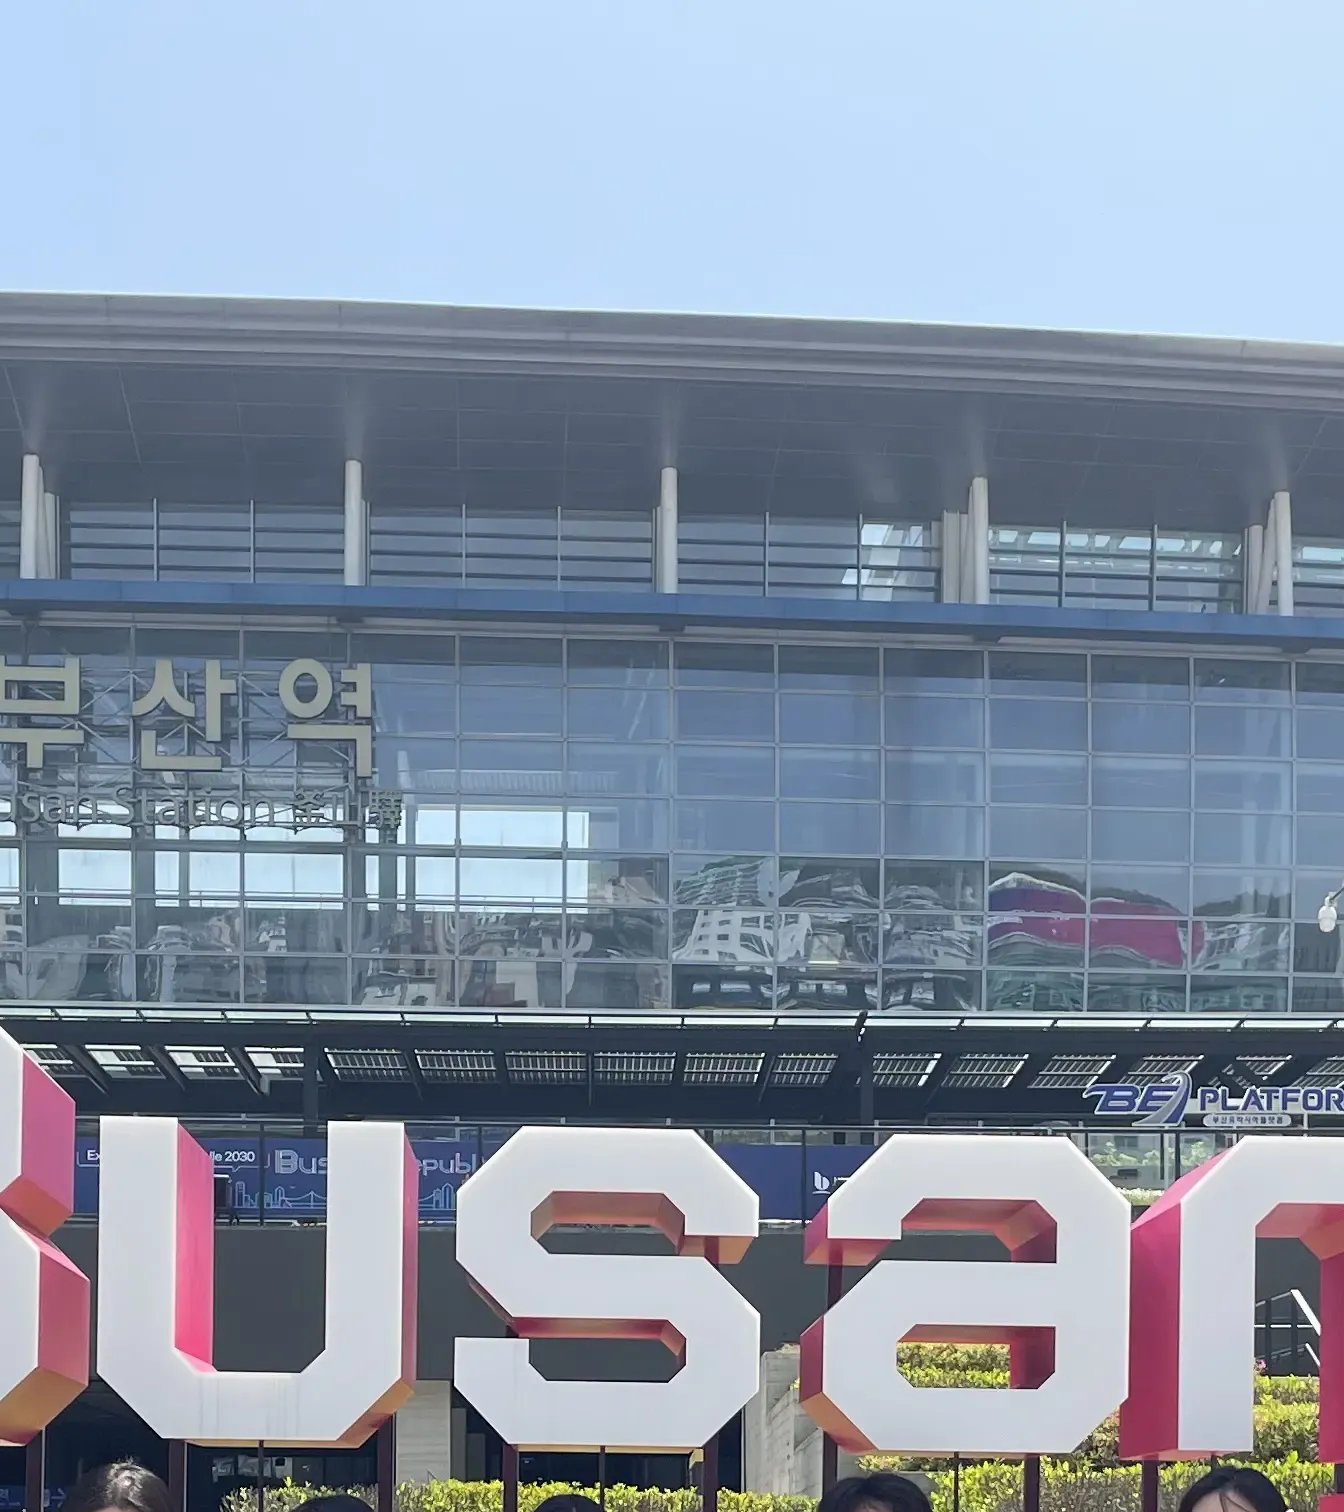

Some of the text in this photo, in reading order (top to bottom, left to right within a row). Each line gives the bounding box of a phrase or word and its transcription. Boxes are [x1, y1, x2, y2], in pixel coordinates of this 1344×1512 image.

[112, 782, 275, 828] Station
[224, 1151, 256, 1162] 2030
[274, 1149, 328, 1175] Bus
